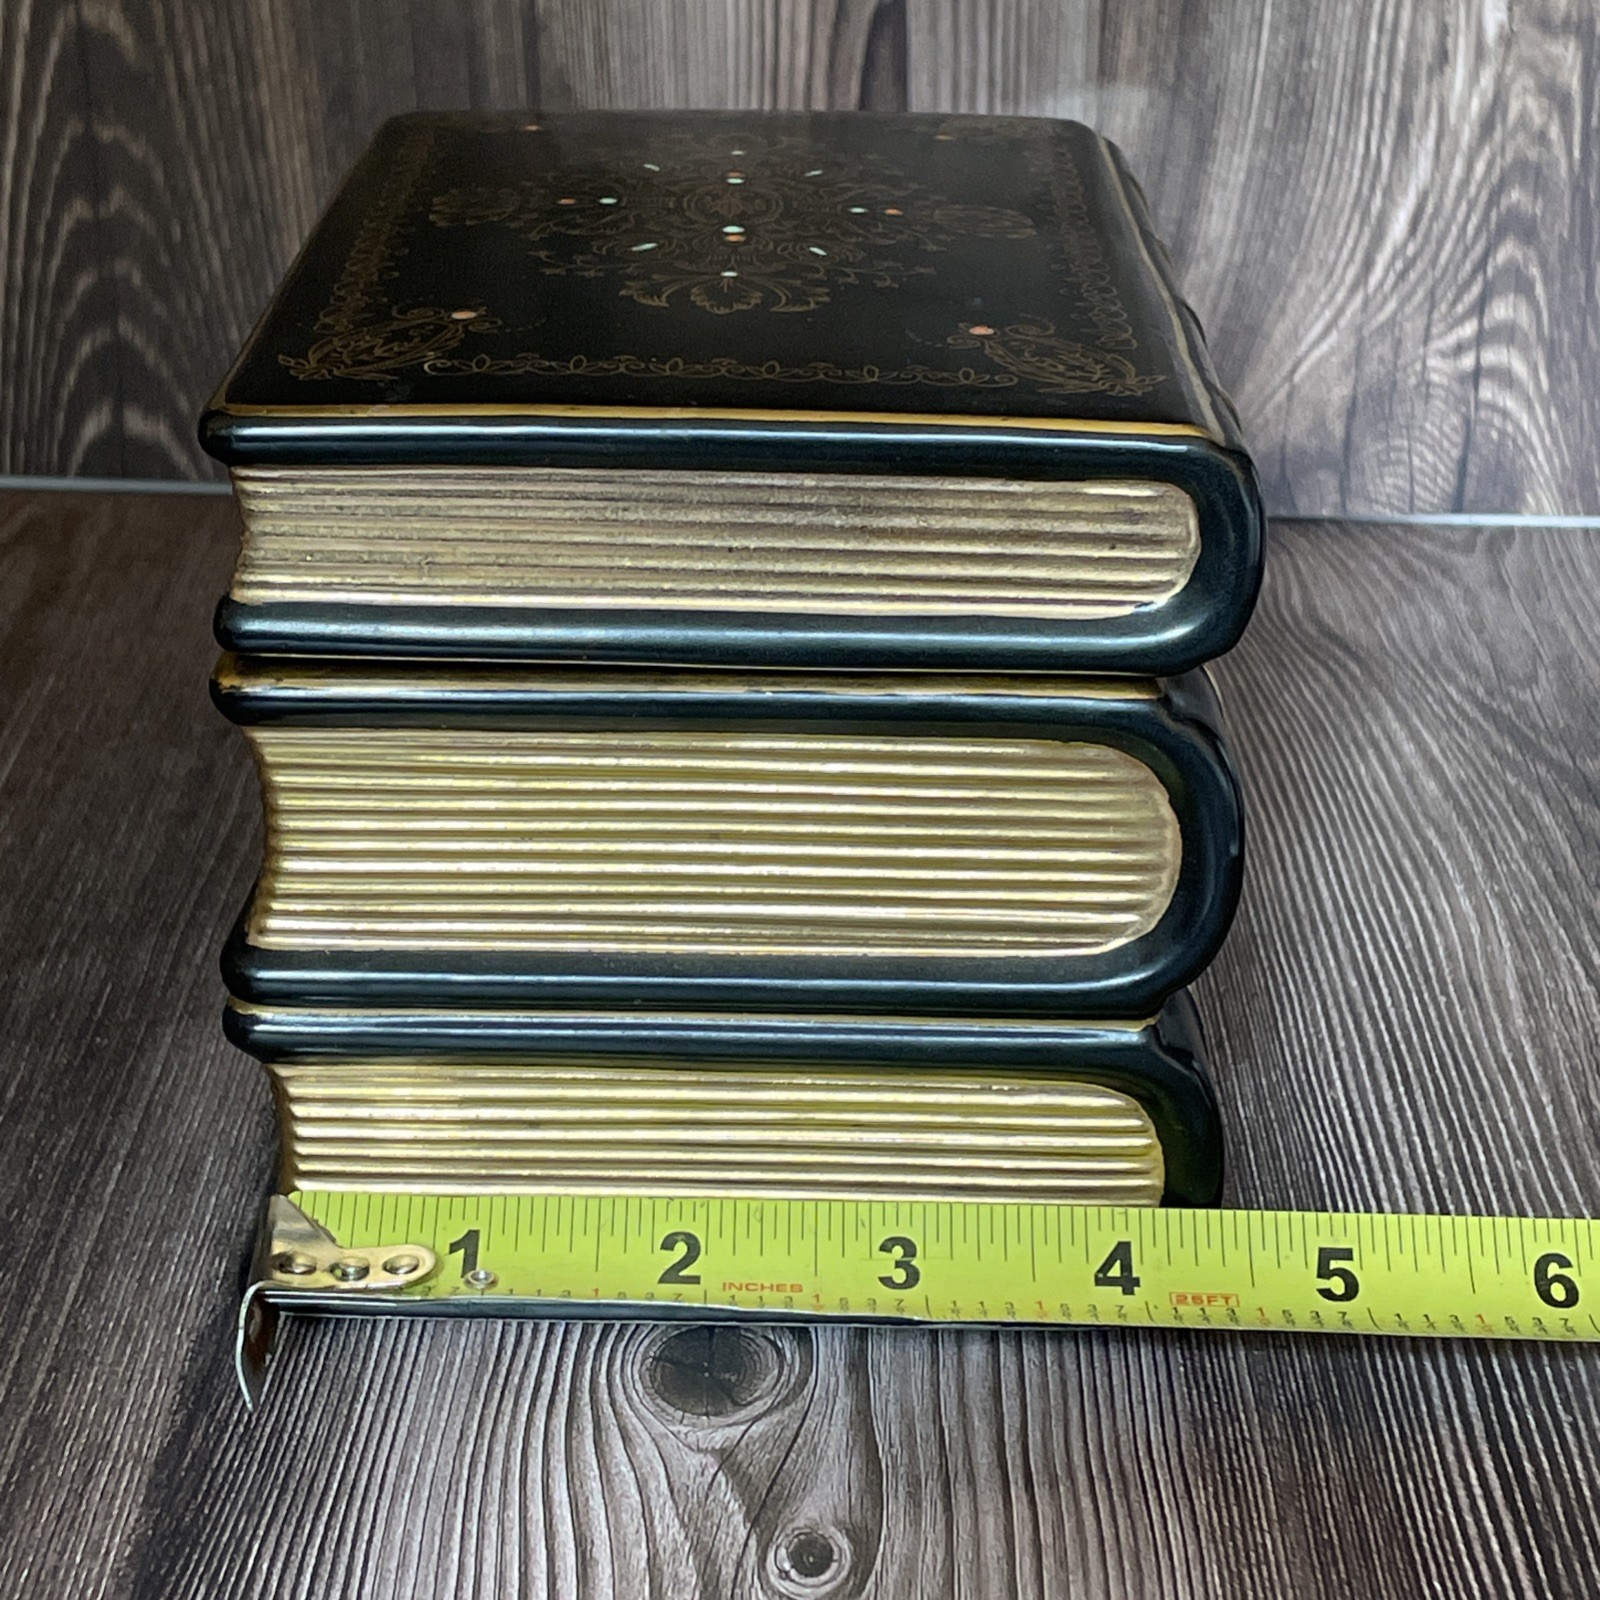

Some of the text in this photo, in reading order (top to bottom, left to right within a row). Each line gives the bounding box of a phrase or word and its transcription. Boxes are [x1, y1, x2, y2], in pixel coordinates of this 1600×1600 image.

[449, 1229, 1580, 1309] 1 2 3 4 5 6
[722, 1281, 804, 1293] INCHES
